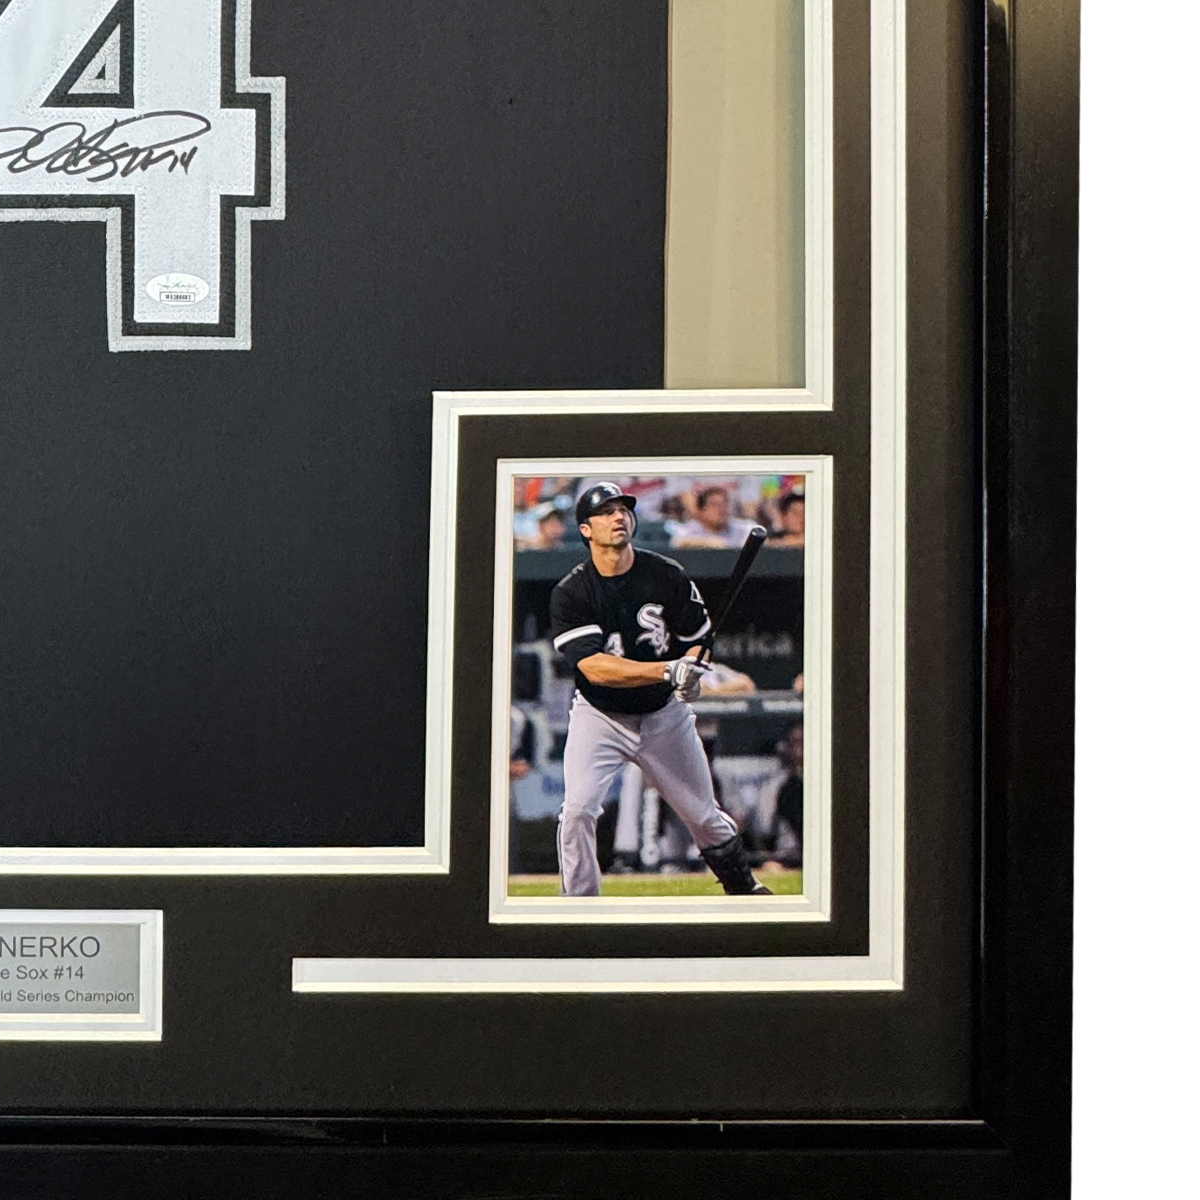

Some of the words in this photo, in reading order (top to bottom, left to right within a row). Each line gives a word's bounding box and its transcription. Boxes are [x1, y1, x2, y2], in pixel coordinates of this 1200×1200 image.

[16, 965, 49, 981] Sox
[54, 966, 85, 981] #14
[17, 989, 61, 1004] Series
[64, 989, 136, 1006] Champion
